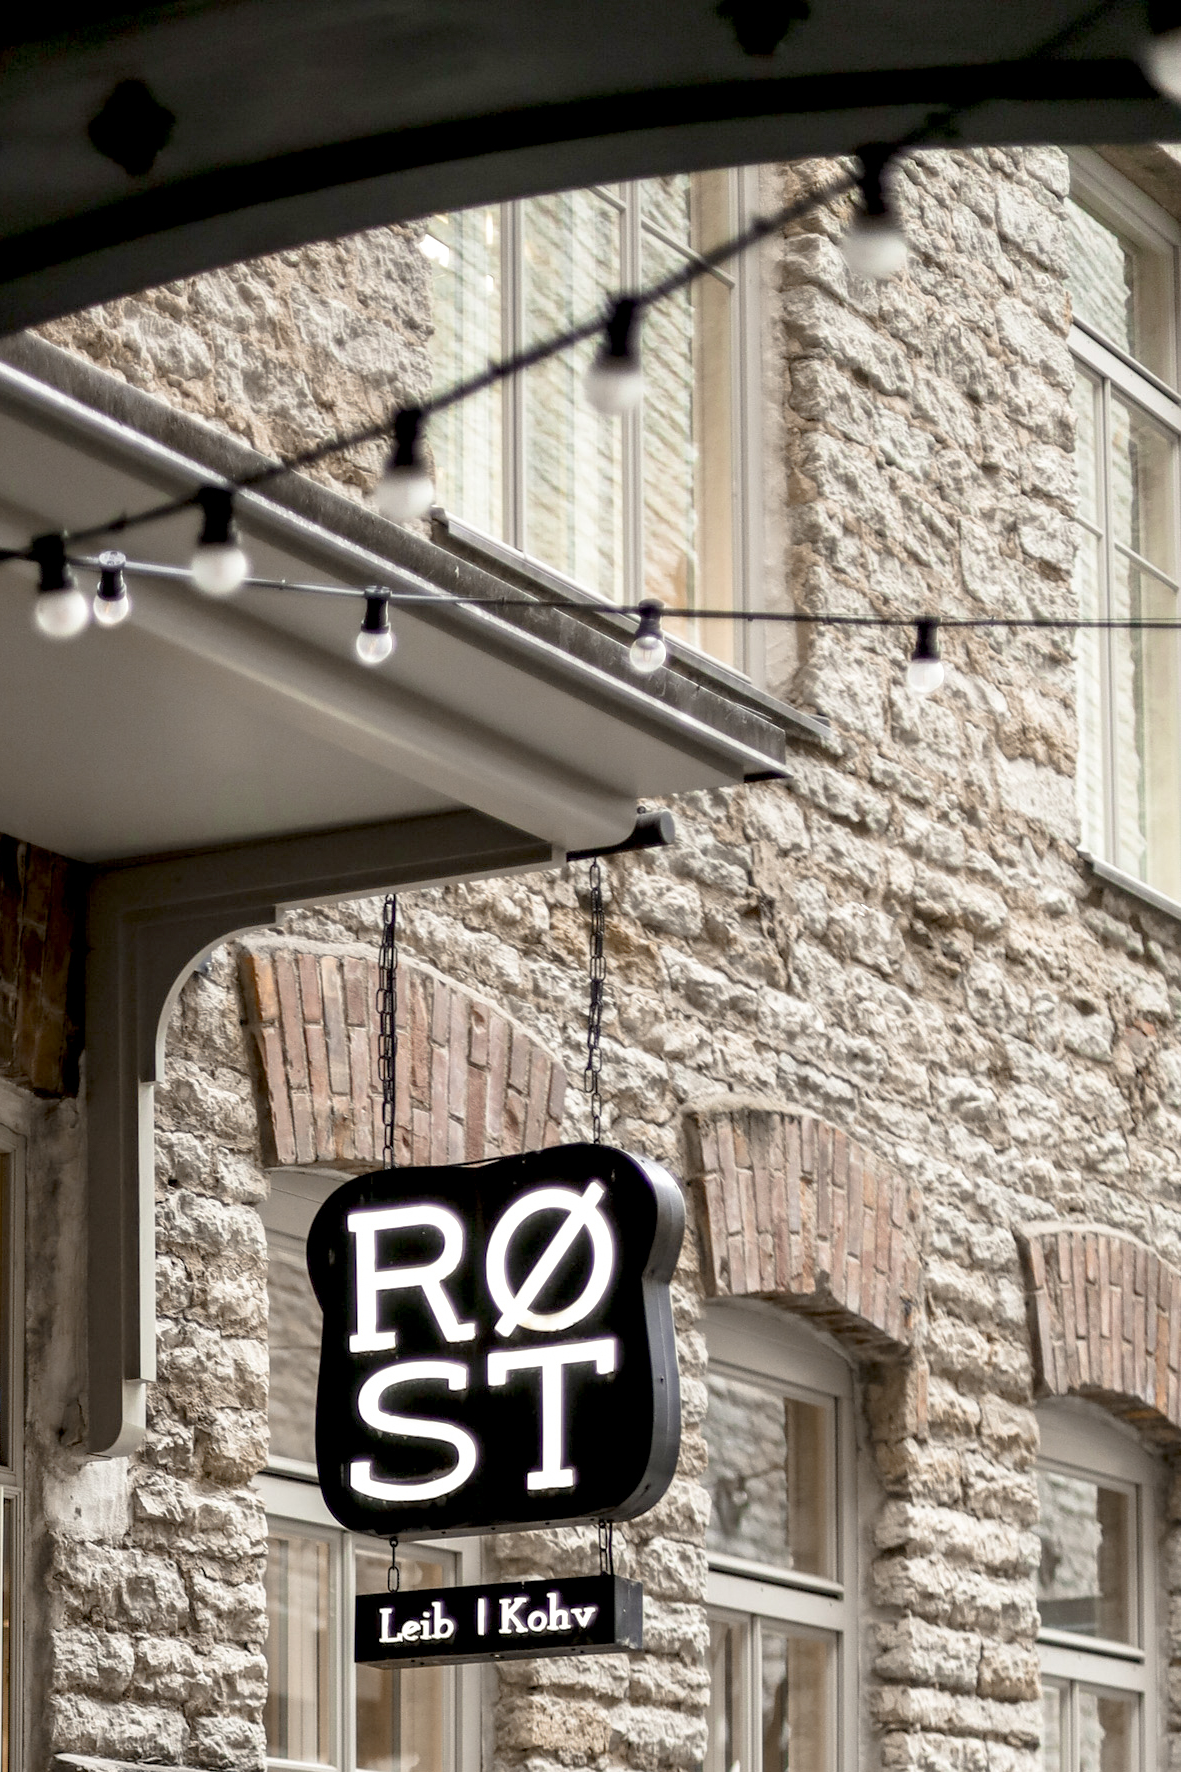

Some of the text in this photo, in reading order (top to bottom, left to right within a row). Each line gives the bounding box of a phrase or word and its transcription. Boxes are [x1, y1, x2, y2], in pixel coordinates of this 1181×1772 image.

[347, 1181, 617, 1354] RØ
[350, 1338, 616, 1503] ST
[378, 1592, 597, 1644] Leib Kohv
